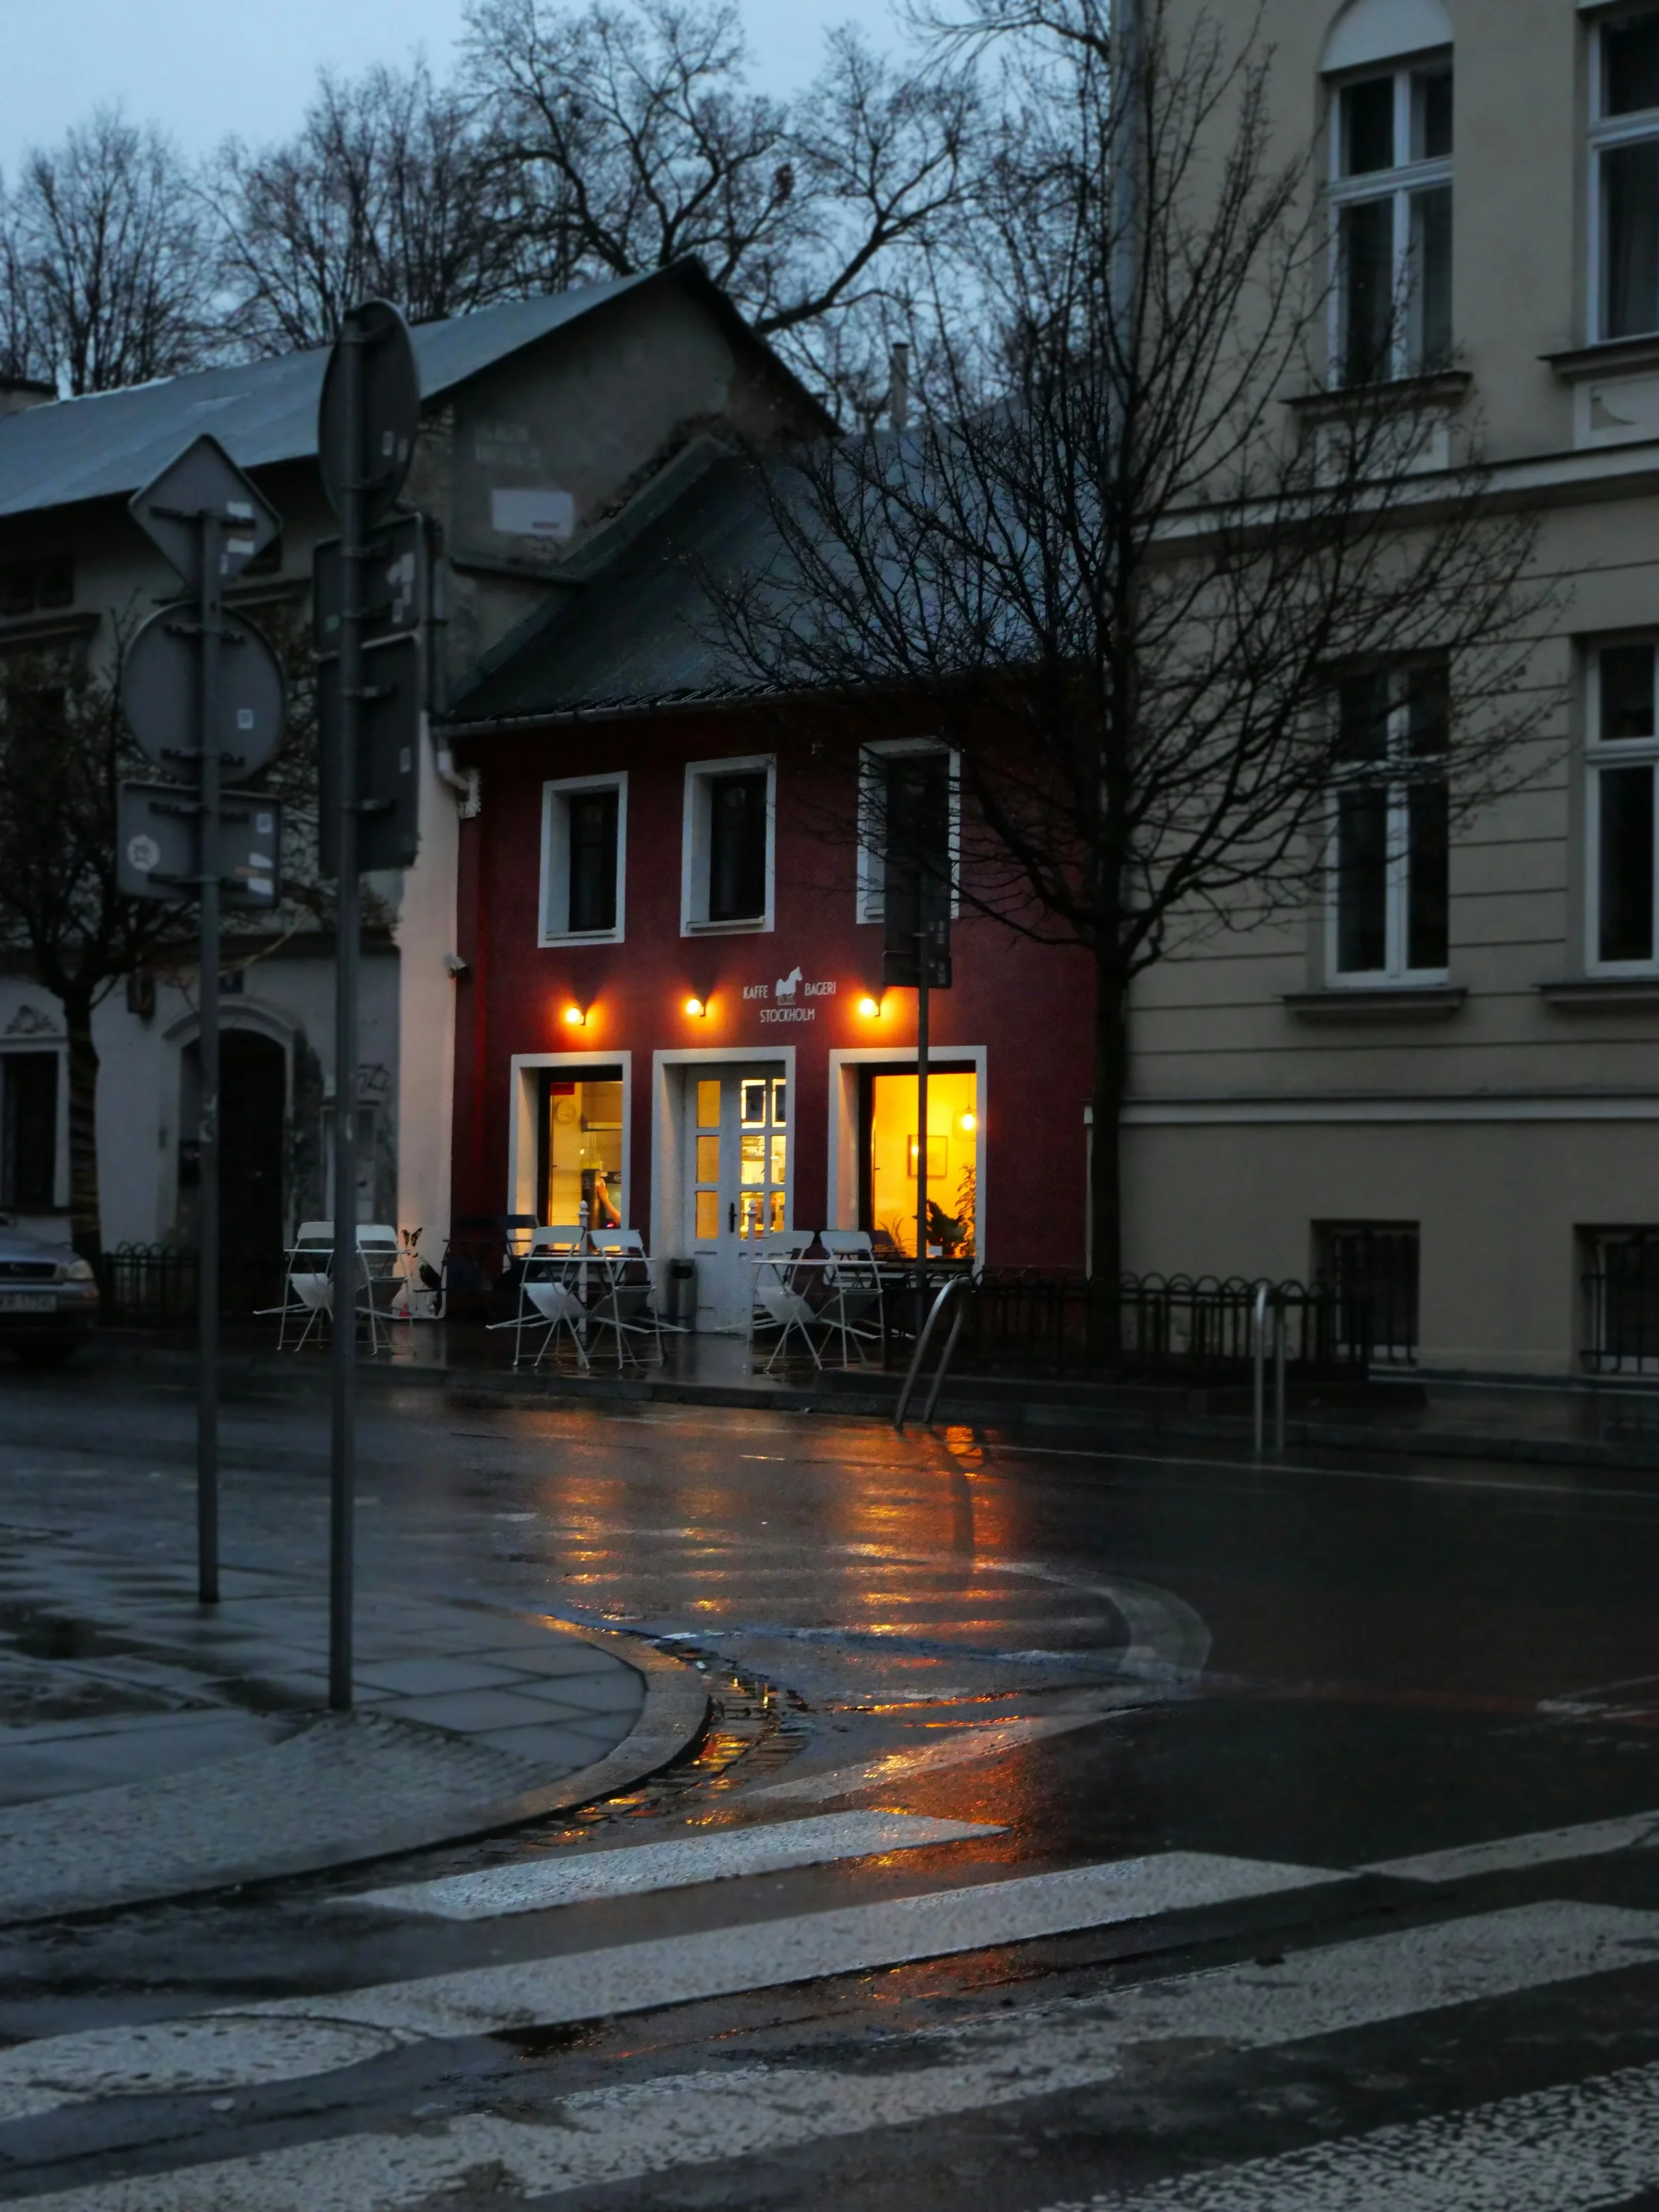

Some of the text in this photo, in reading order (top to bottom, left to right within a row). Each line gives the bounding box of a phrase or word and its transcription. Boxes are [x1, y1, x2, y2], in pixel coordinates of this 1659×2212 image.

[743, 981, 836, 999] KAFFE BAGERI
[760, 1008, 815, 1023] STOCKHOLM
